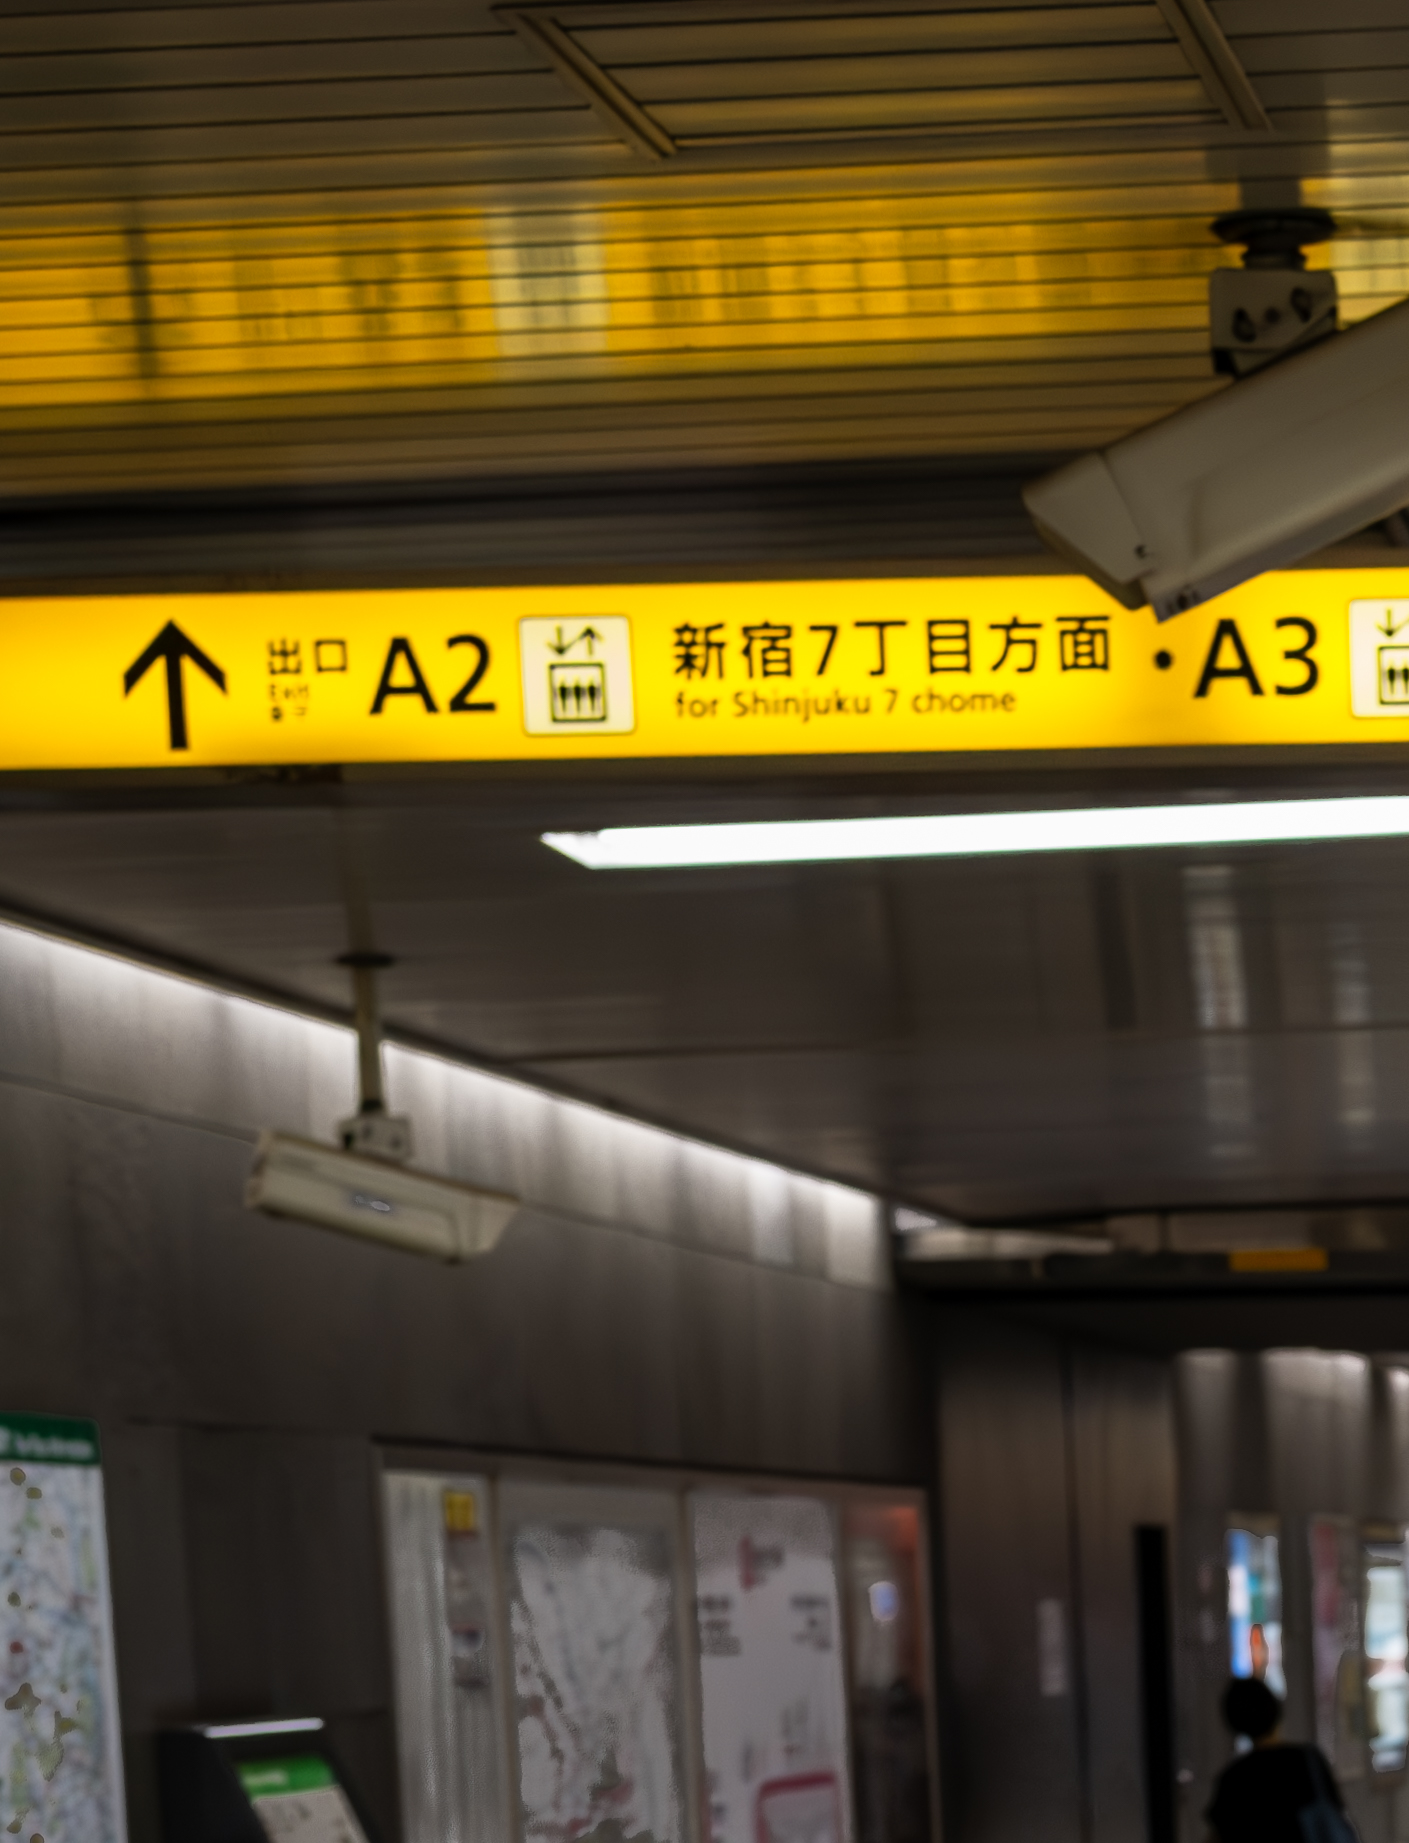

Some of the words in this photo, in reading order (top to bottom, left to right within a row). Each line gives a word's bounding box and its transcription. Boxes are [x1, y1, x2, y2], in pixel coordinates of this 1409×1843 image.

[267, 637, 348, 675] 出口
[369, 633, 497, 716] A2
[672, 614, 1112, 682] 新宿7丁目方面
[676, 691, 718, 718] for
[733, 688, 871, 723] Shinjuku
[885, 688, 899, 715] 7
[911, 686, 1016, 714] chome
